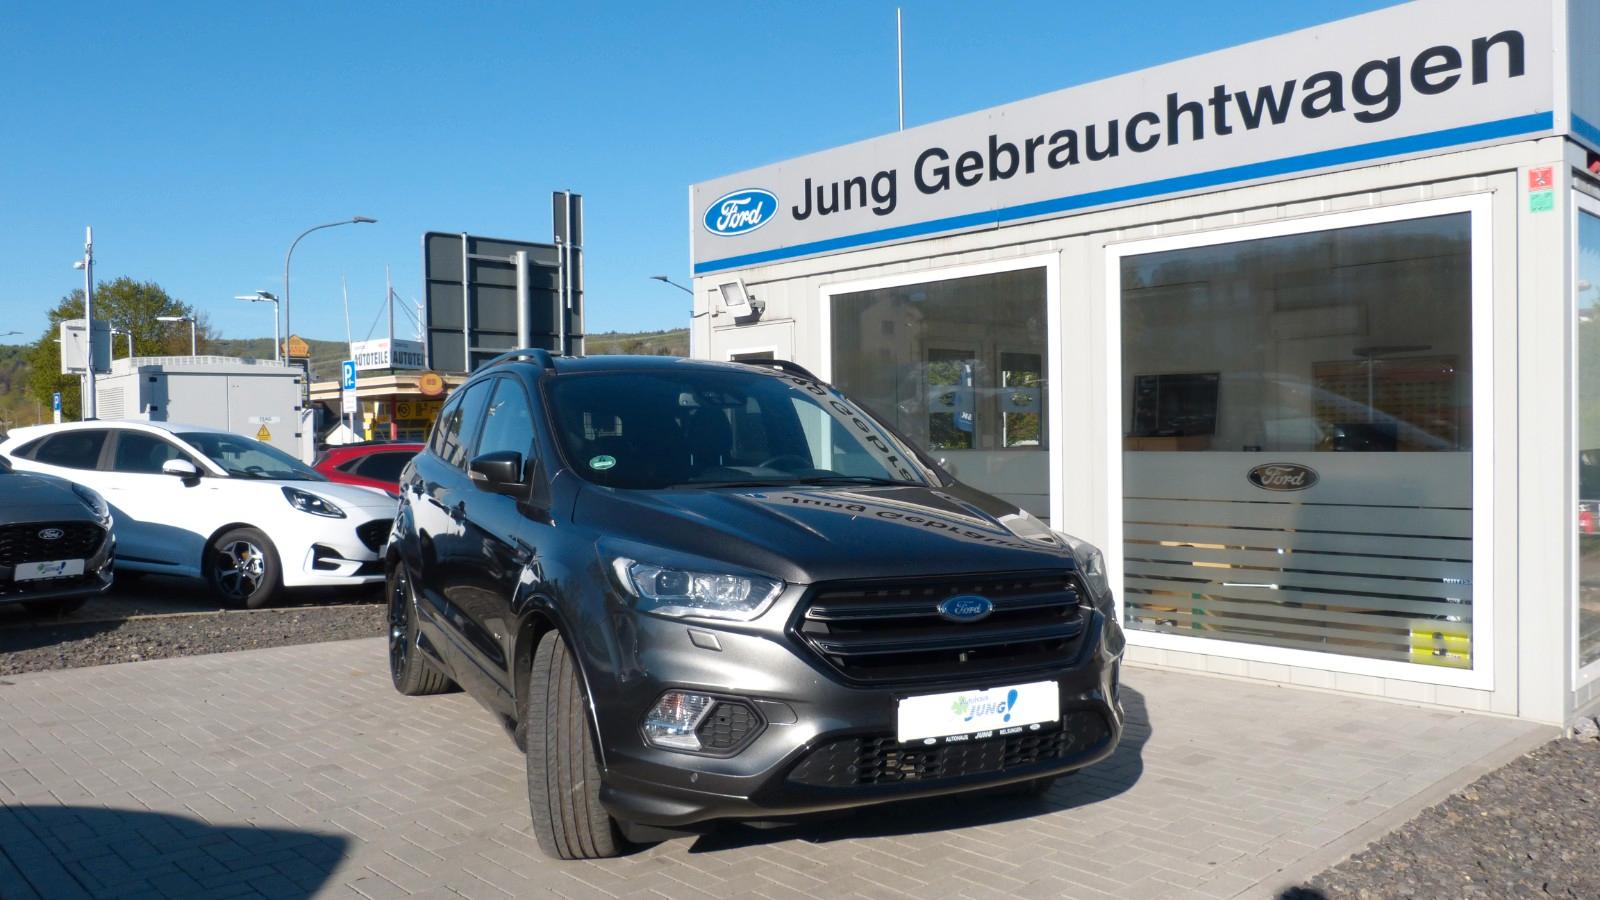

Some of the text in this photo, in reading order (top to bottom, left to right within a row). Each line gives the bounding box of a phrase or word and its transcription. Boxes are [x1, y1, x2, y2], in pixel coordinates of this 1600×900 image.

[791, 168, 897, 221] Jung
[913, 29, 1525, 195] Gebrauchtwagen
[717, 196, 764, 231] Ford
[344, 364, 353, 387] P
[1260, 466, 1305, 485] Ford
[954, 601, 982, 614] Ford
[945, 734, 969, 743] AUTOHAUS
[974, 730, 993, 740] JUNG
